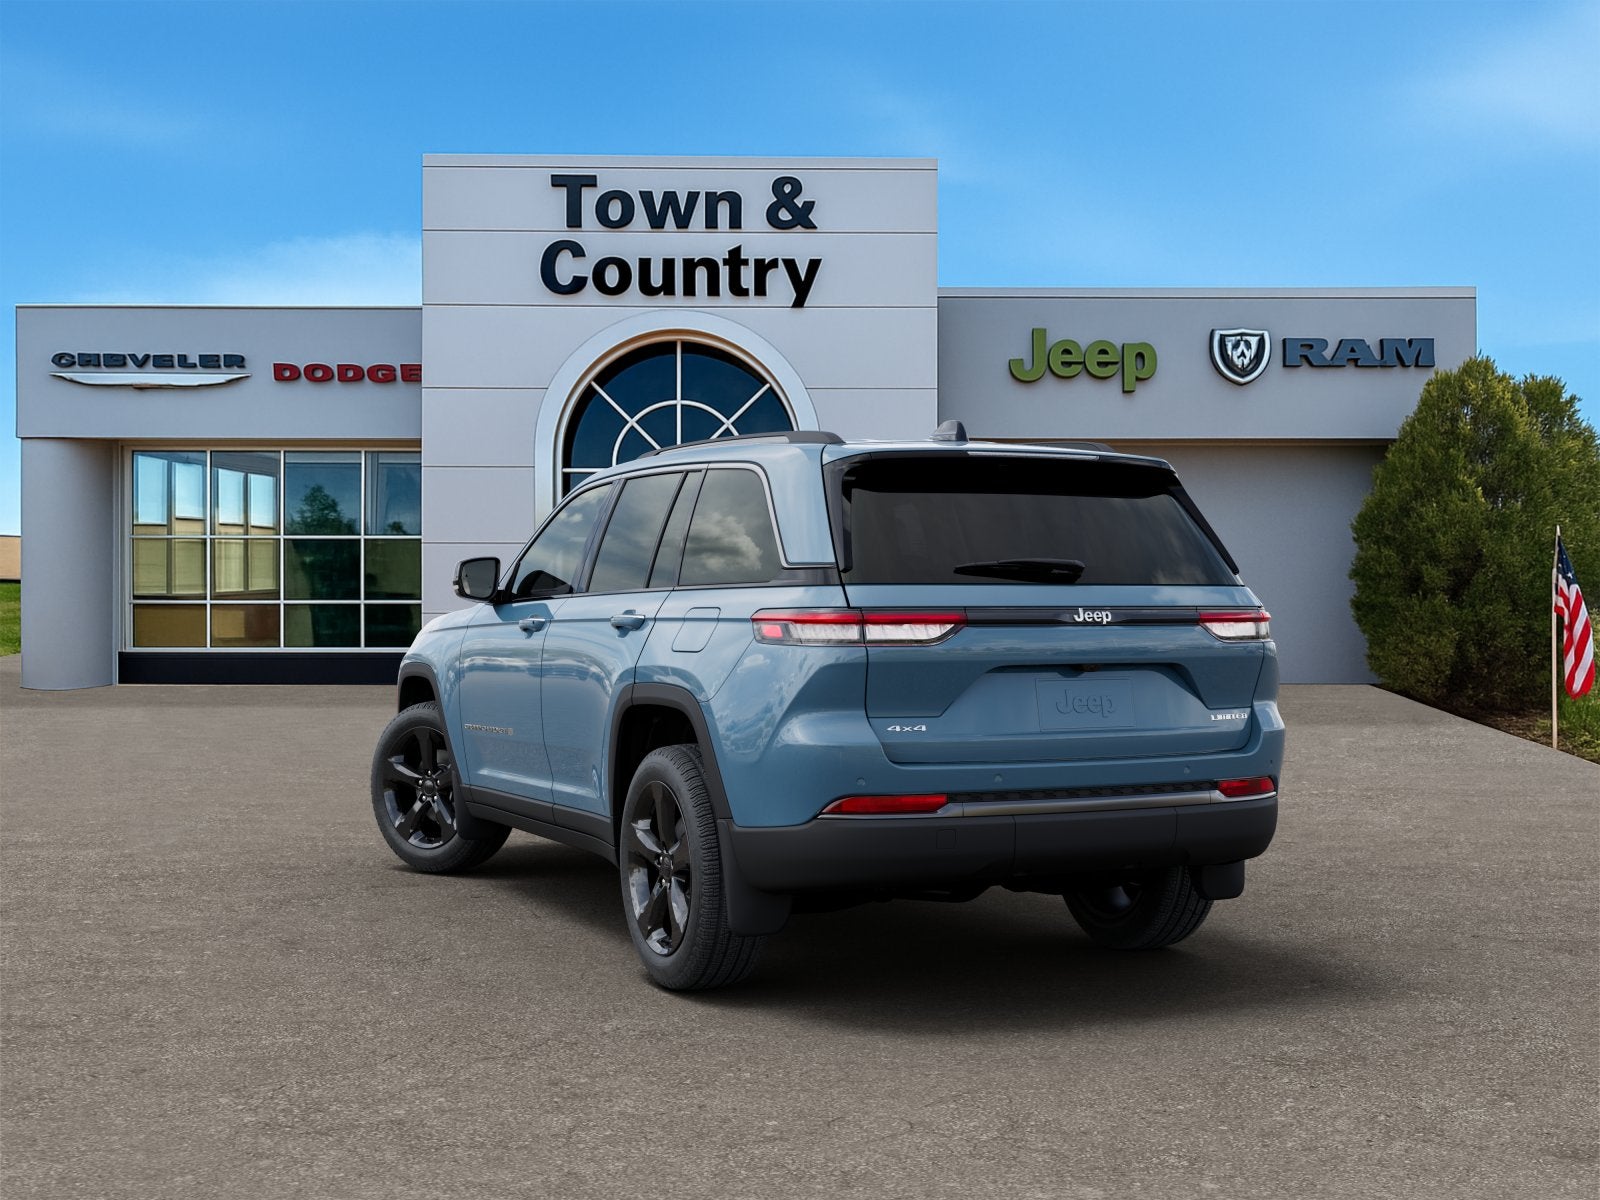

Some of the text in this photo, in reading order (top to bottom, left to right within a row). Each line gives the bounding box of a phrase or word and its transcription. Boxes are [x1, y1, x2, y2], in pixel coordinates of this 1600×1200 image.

[550, 174, 818, 230] Town &
[540, 239, 822, 309] Country
[1008, 327, 1158, 393] Jeep
[1283, 337, 1436, 368] RAM
[272, 362, 422, 383] DODGE
[1073, 607, 1112, 625] Jeep
[1055, 689, 1117, 718] Jeep
[886, 724, 927, 733] 4x4
